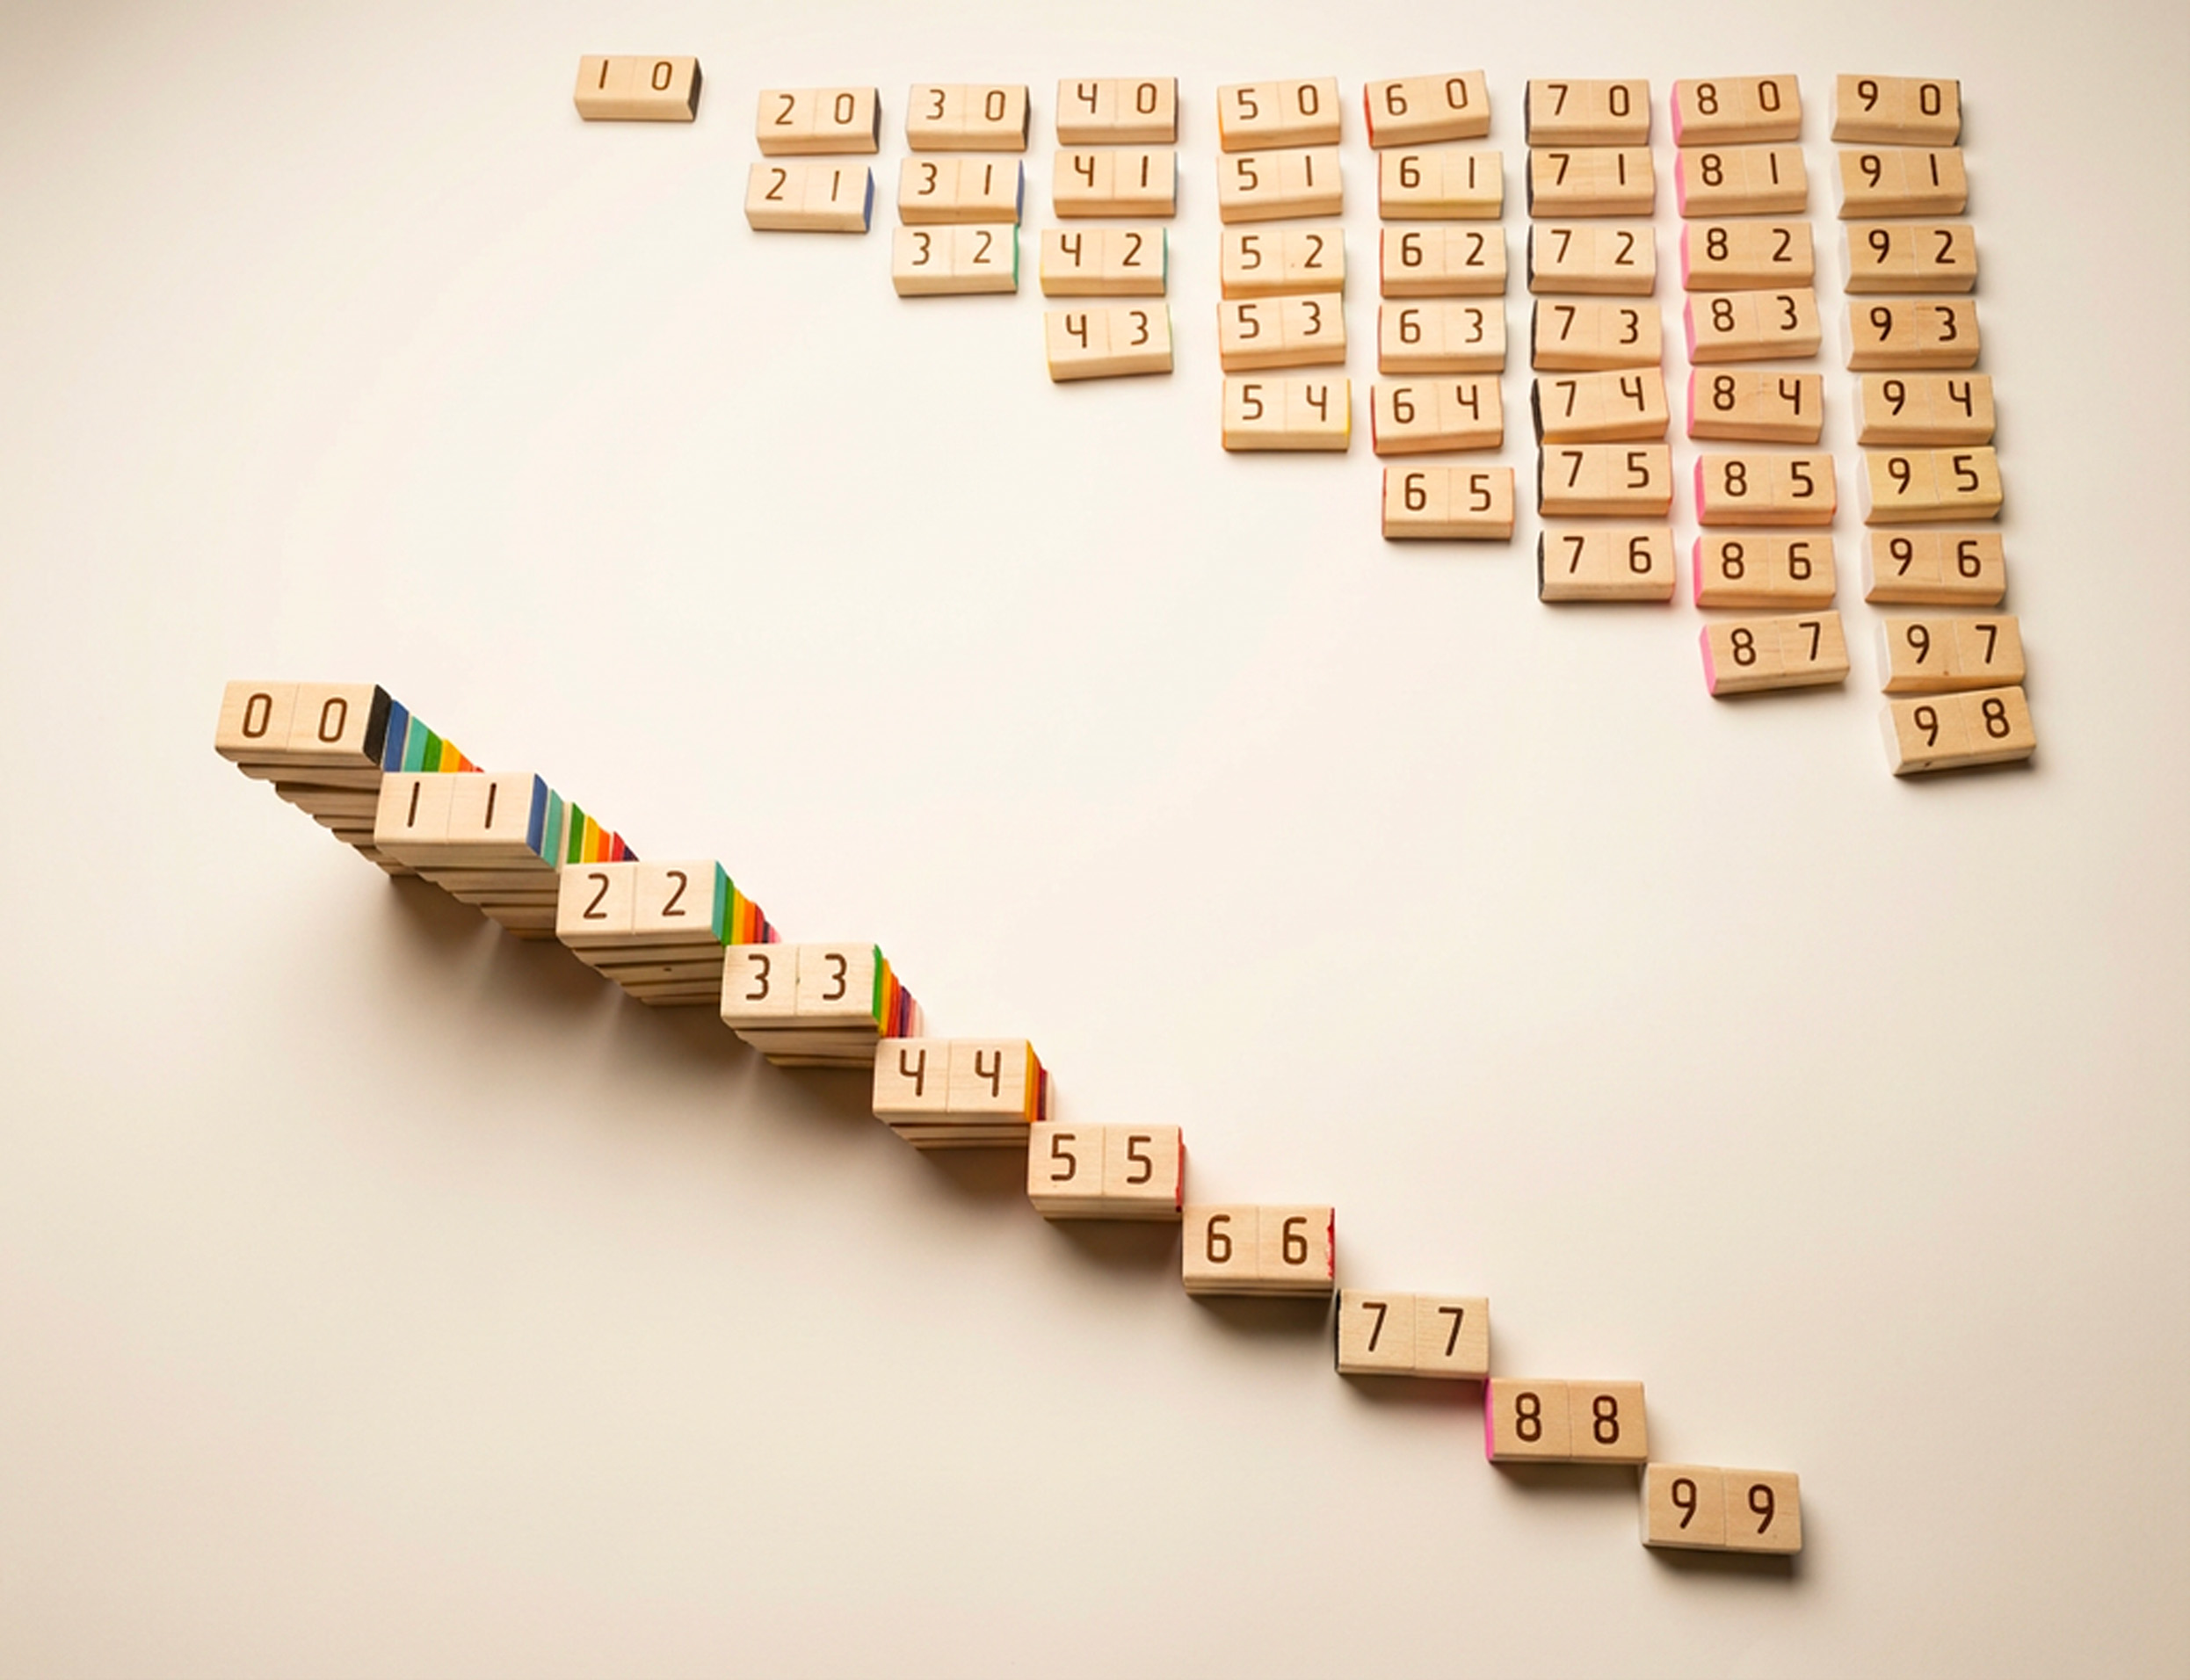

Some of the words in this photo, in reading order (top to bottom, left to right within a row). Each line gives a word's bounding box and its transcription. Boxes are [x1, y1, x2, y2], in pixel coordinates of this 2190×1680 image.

[650, 60, 674, 92] 0
[774, 93, 796, 127] 2
[833, 91, 856, 126] 0
[925, 88, 946, 121] 3
[983, 89, 1007, 123] 0
[1076, 82, 1099, 115] 4
[1135, 82, 1158, 115] 0
[1236, 87, 1259, 121] 5
[1296, 83, 1320, 117] 0
[1384, 83, 1409, 117] 6
[1444, 76, 1469, 111] 0
[1546, 83, 1570, 117] 7
[1607, 83, 1631, 118] 0
[1695, 82, 1720, 116] 8
[1757, 79, 1781, 113] 0
[1856, 78, 1880, 112] 9
[1918, 83, 1942, 117] 0
[764, 167, 787, 202] 2
[917, 162, 939, 196] 3
[1073, 154, 1096, 189] 4
[1236, 157, 1259, 192] 5
[1399, 155, 1422, 190] 6
[1548, 152, 1570, 187] 7
[1700, 153, 1724, 188] 8
[1859, 153, 1882, 189] 9
[911, 231, 932, 267] 3
[972, 229, 993, 264] 2
[1059, 232, 1083, 268] 4
[1121, 231, 1143, 268] 2
[1240, 235, 1262, 271] 5
[1302, 233, 1324, 270] 2
[1400, 231, 1424, 268] 6
[1464, 231, 1485, 267] 2
[1550, 228, 1573, 264] 7
[1613, 230, 1635, 266] 2
[1705, 227, 1730, 263] 8
[1771, 227, 1794, 264] 2
[1867, 228, 1891, 264] 9
[1933, 228, 1956, 265] 2
[1064, 313, 1089, 350] 4
[1128, 309, 1149, 347] 3
[1236, 303, 1261, 340] 5
[1301, 300, 1323, 337] 3
[1398, 308, 1422, 345] 6
[1463, 307, 1484, 344] 3
[1553, 304, 1577, 342] 7
[1618, 308, 1640, 345] 3
[1710, 297, 1736, 334] 8
[1775, 293, 1799, 332] 3
[1868, 306, 1894, 343] 9
[1933, 305, 1958, 343] 3
[1241, 383, 1265, 422] 5
[1305, 384, 1329, 424] 4
[1392, 387, 1416, 425] 6
[1455, 383, 1480, 422] 4
[1555, 379, 1577, 418] 7
[1619, 374, 1646, 413] 4
[1712, 374, 1737, 412] 8
[1778, 377, 1802, 416] 4
[1882, 379, 1906, 417] 9
[1947, 380, 1973, 418] 4
[1560, 449, 1584, 489] 7
[1626, 451, 1650, 489] 5
[1723, 460, 1749, 498] 8
[1789, 460, 1815, 499] 5
[1887, 456, 1912, 496] 9
[1952, 453, 1980, 493] 5
[1403, 472, 1428, 512] 6
[1468, 473, 1492, 513] 5
[1562, 534, 1585, 575] 7
[1628, 534, 1653, 576] 6
[1720, 540, 1745, 581] 8
[1788, 541, 1813, 582] 6
[1889, 537, 1914, 577] 9
[1956, 539, 1982, 579] 6
[1730, 626, 1758, 668] 8
[1797, 620, 1822, 663] 7
[1905, 623, 1931, 665] 9
[1974, 623, 1998, 665] 7
[241, 692, 274, 740] 0
[316, 696, 349, 743] 0
[1912, 705, 1940, 749] 9
[1980, 697, 2012, 740] 8
[582, 872, 611, 921] 2
[660, 869, 689, 918] 2
[744, 952, 772, 1002] 3
[821, 952, 848, 1002] 3
[898, 1047, 927, 1098] 4
[974, 1048, 1003, 1099] 4
[1049, 1132, 1077, 1183] 5
[1125, 1134, 1154, 1185] 5
[1206, 1213, 1233, 1264] 6
[1281, 1215, 1309, 1266] 6
[1360, 1300, 1389, 1353] 7
[1437, 1305, 1465, 1358] 7
[1514, 1391, 1543, 1444] 8
[1592, 1394, 1621, 1445] 8
[1671, 1476, 1698, 1531] 9
[1747, 1482, 1776, 1536] 9
